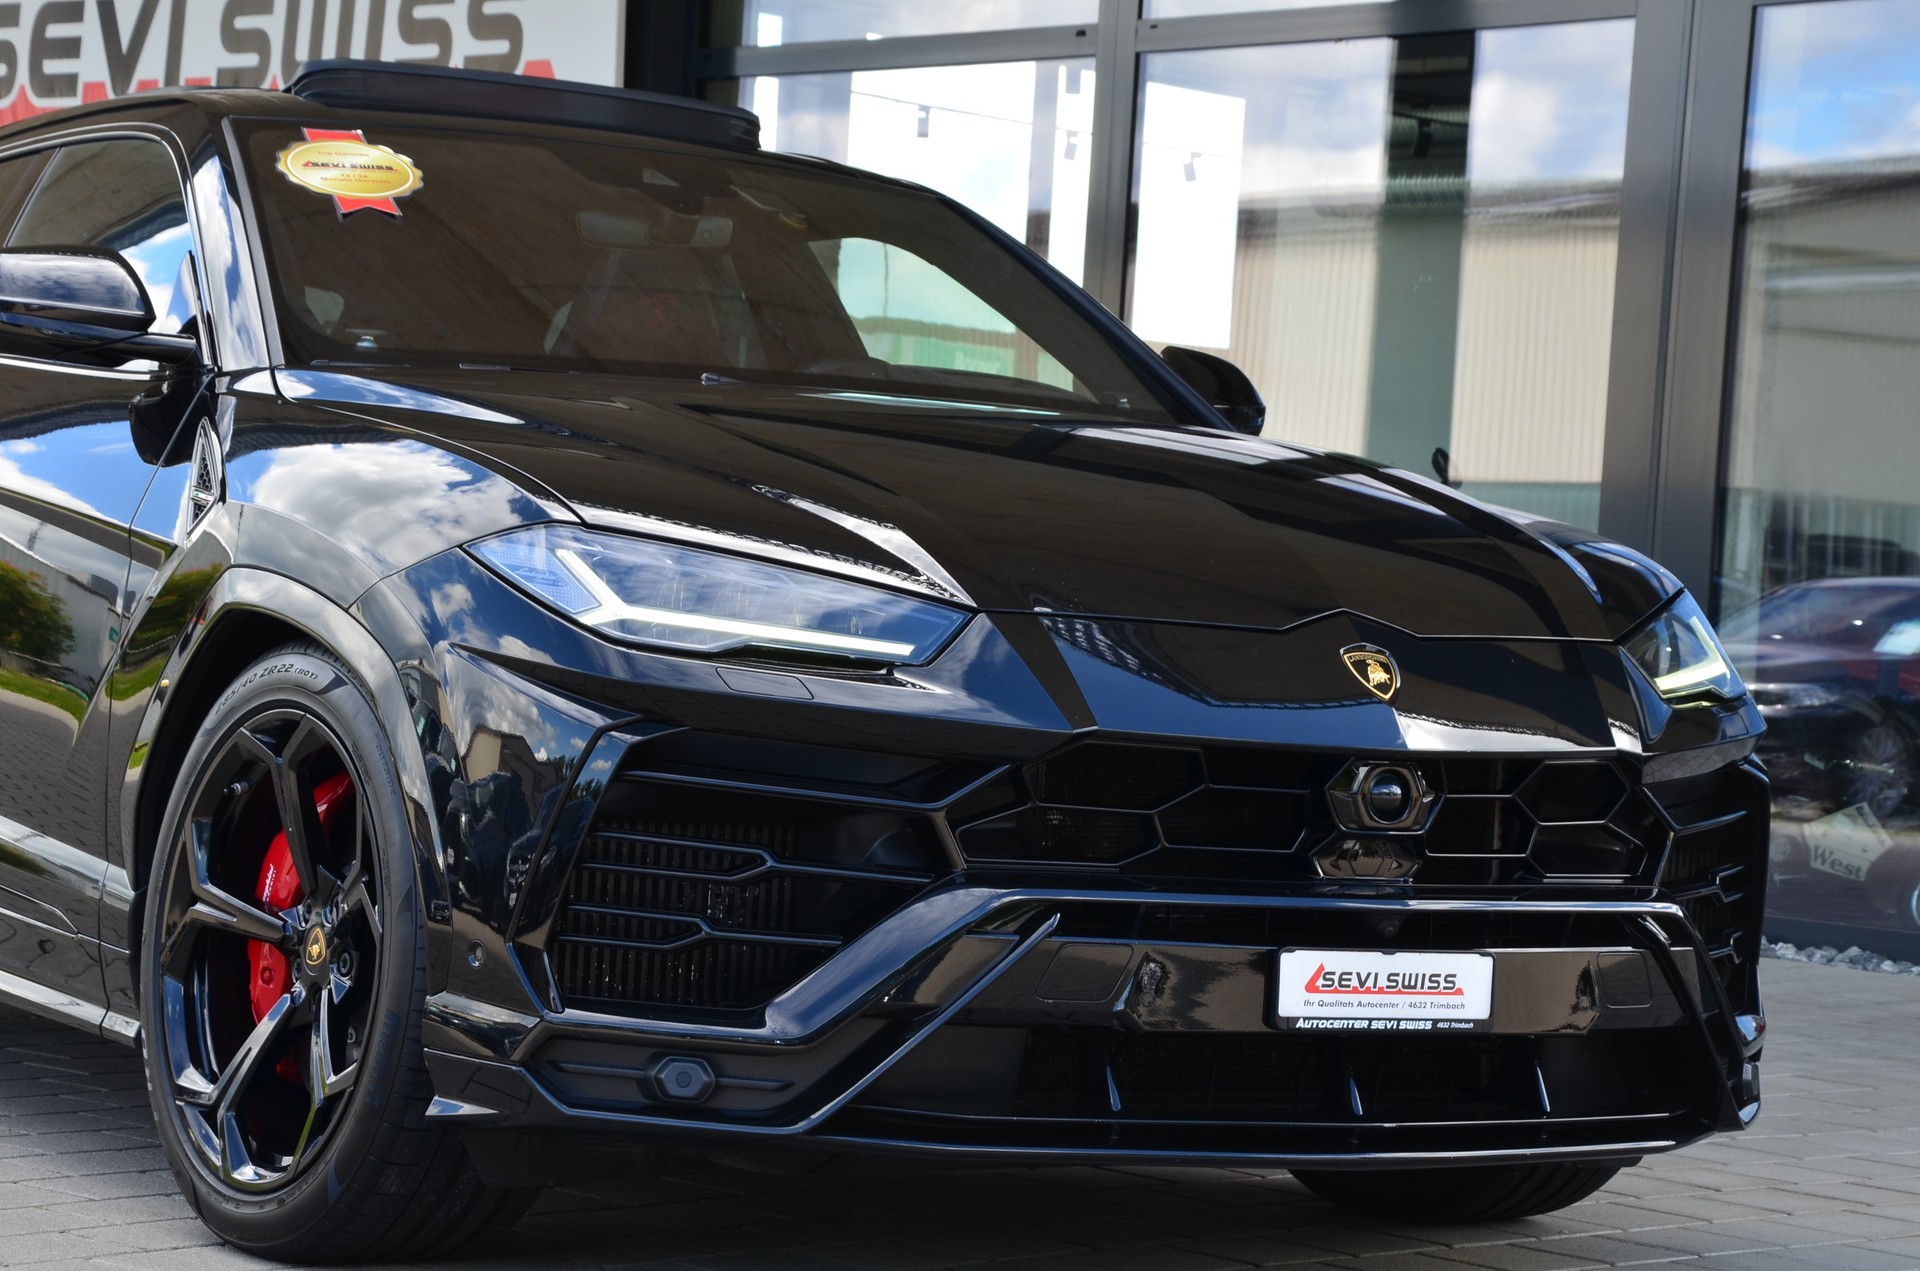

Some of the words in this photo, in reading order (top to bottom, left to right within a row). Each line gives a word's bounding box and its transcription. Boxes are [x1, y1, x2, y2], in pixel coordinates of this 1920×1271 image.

[217, 0, 525, 90] SWISS
[259, 663, 294, 679] ZR22
[1813, 844, 1863, 880] West
[1321, 971, 1379, 989] SEVI
[1385, 972, 1457, 990] SWISS
[1303, 999, 1315, 1007] Ihr
[1356, 1000, 1400, 1009] Autocenter
[1407, 1001, 1428, 1009] 4632
[1429, 1002, 1466, 1010] Trimbach
[1370, 1019, 1398, 1030] SEVI
[1398, 1019, 1433, 1030] SWISS
